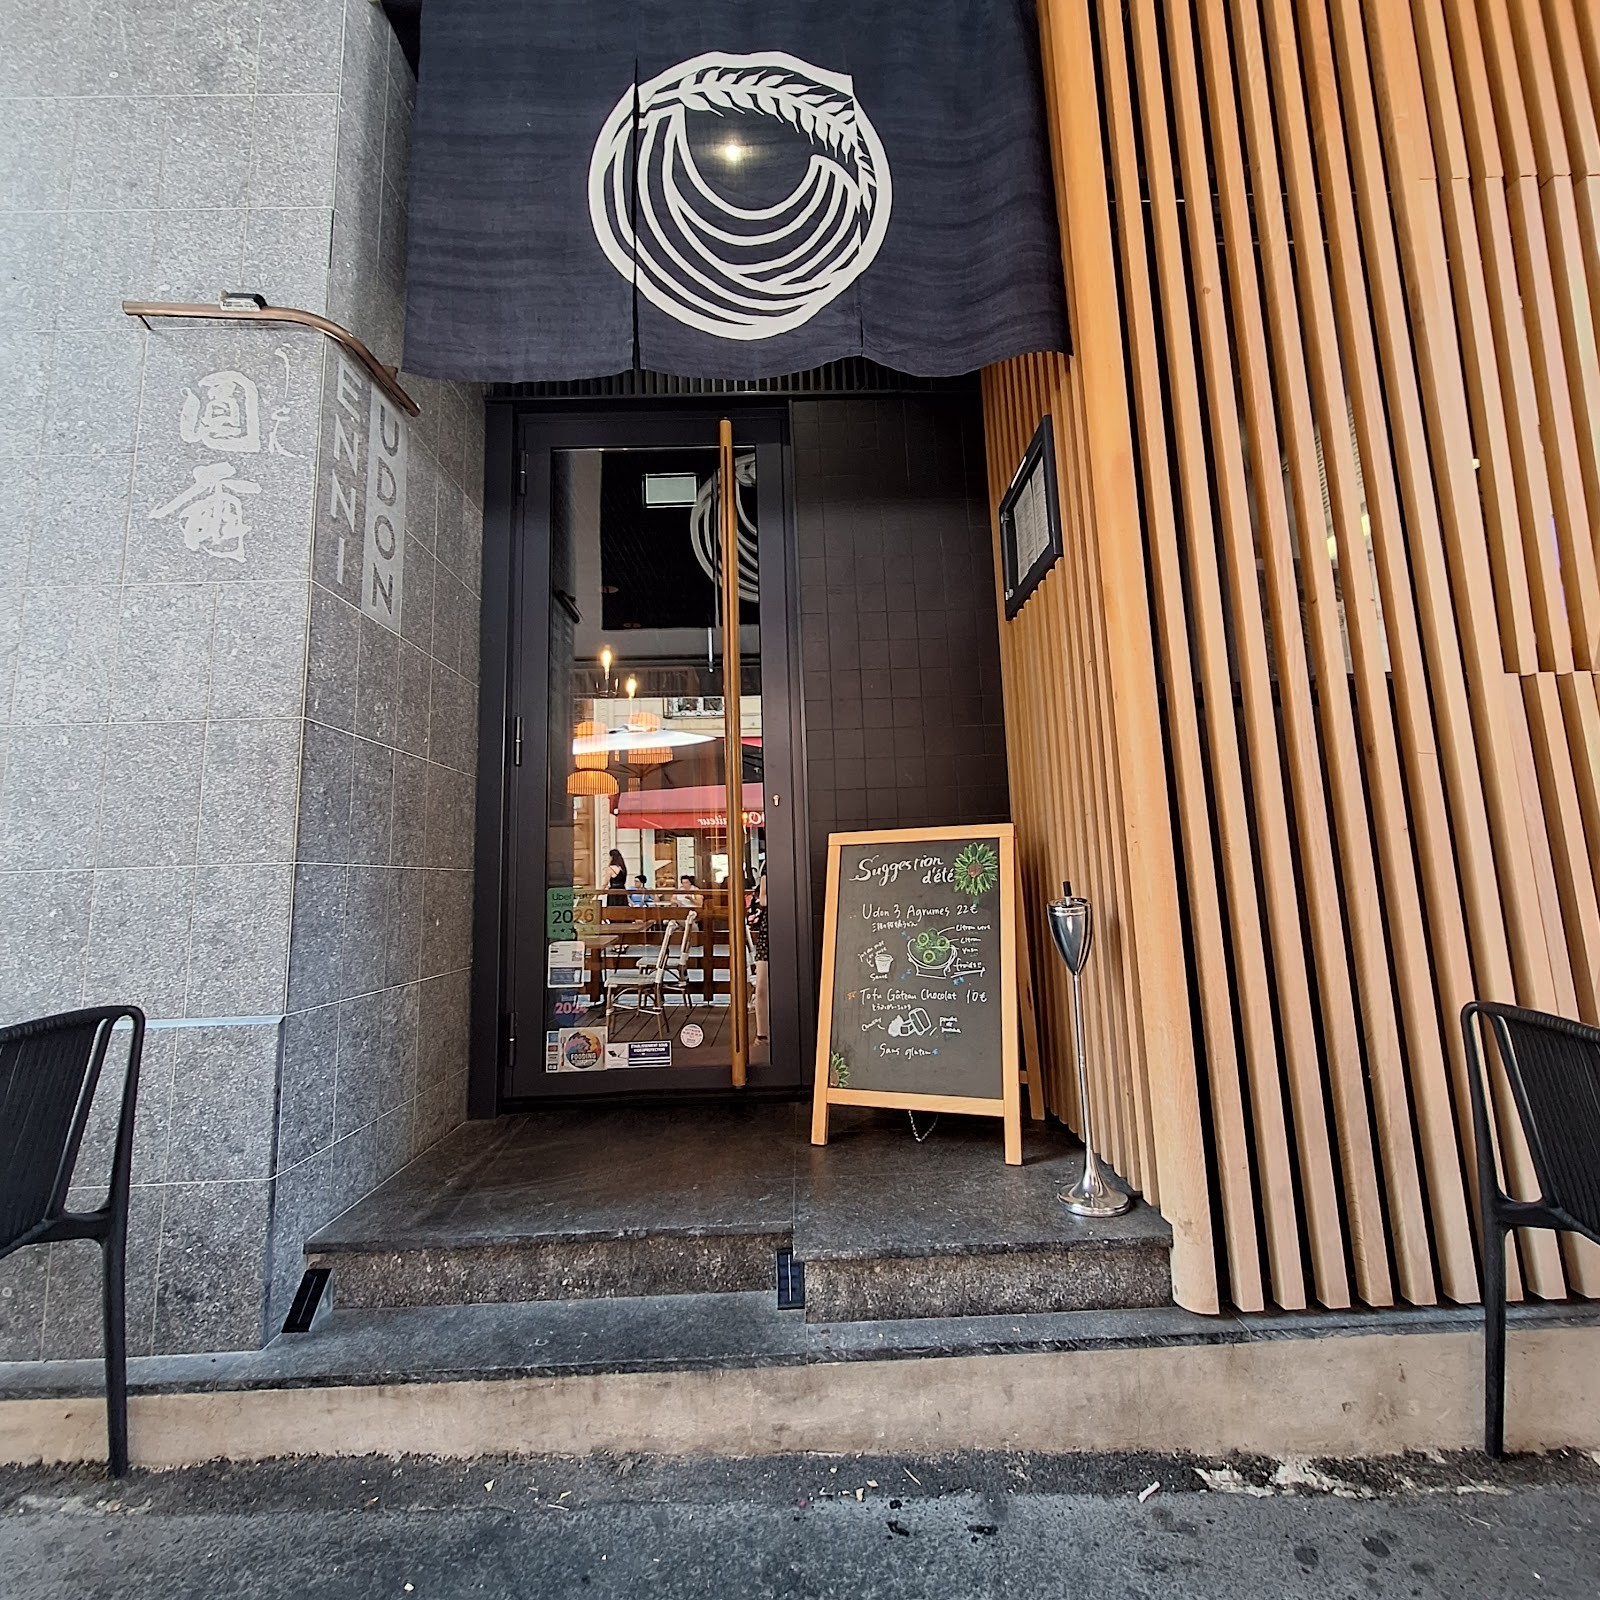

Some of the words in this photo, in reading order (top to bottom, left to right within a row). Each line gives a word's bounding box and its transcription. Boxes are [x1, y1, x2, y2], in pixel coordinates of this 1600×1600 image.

[330, 356, 362, 585] ENNI
[371, 402, 400, 616] UDON
[849, 854, 944, 886] Suggestion
[922, 867, 955, 884] d'été
[552, 909, 594, 924] 2026
[862, 904, 890, 919] Udon
[893, 904, 901, 918] 3
[907, 904, 950, 922] Agrumes
[956, 904, 978, 915] 22€
[860, 987, 882, 1005] Tofu
[887, 988, 917, 1002] Gâteau
[920, 988, 957, 1001] Chocolat
[966, 989, 988, 1004] 10€
[879, 1043, 901, 1058] Sans
